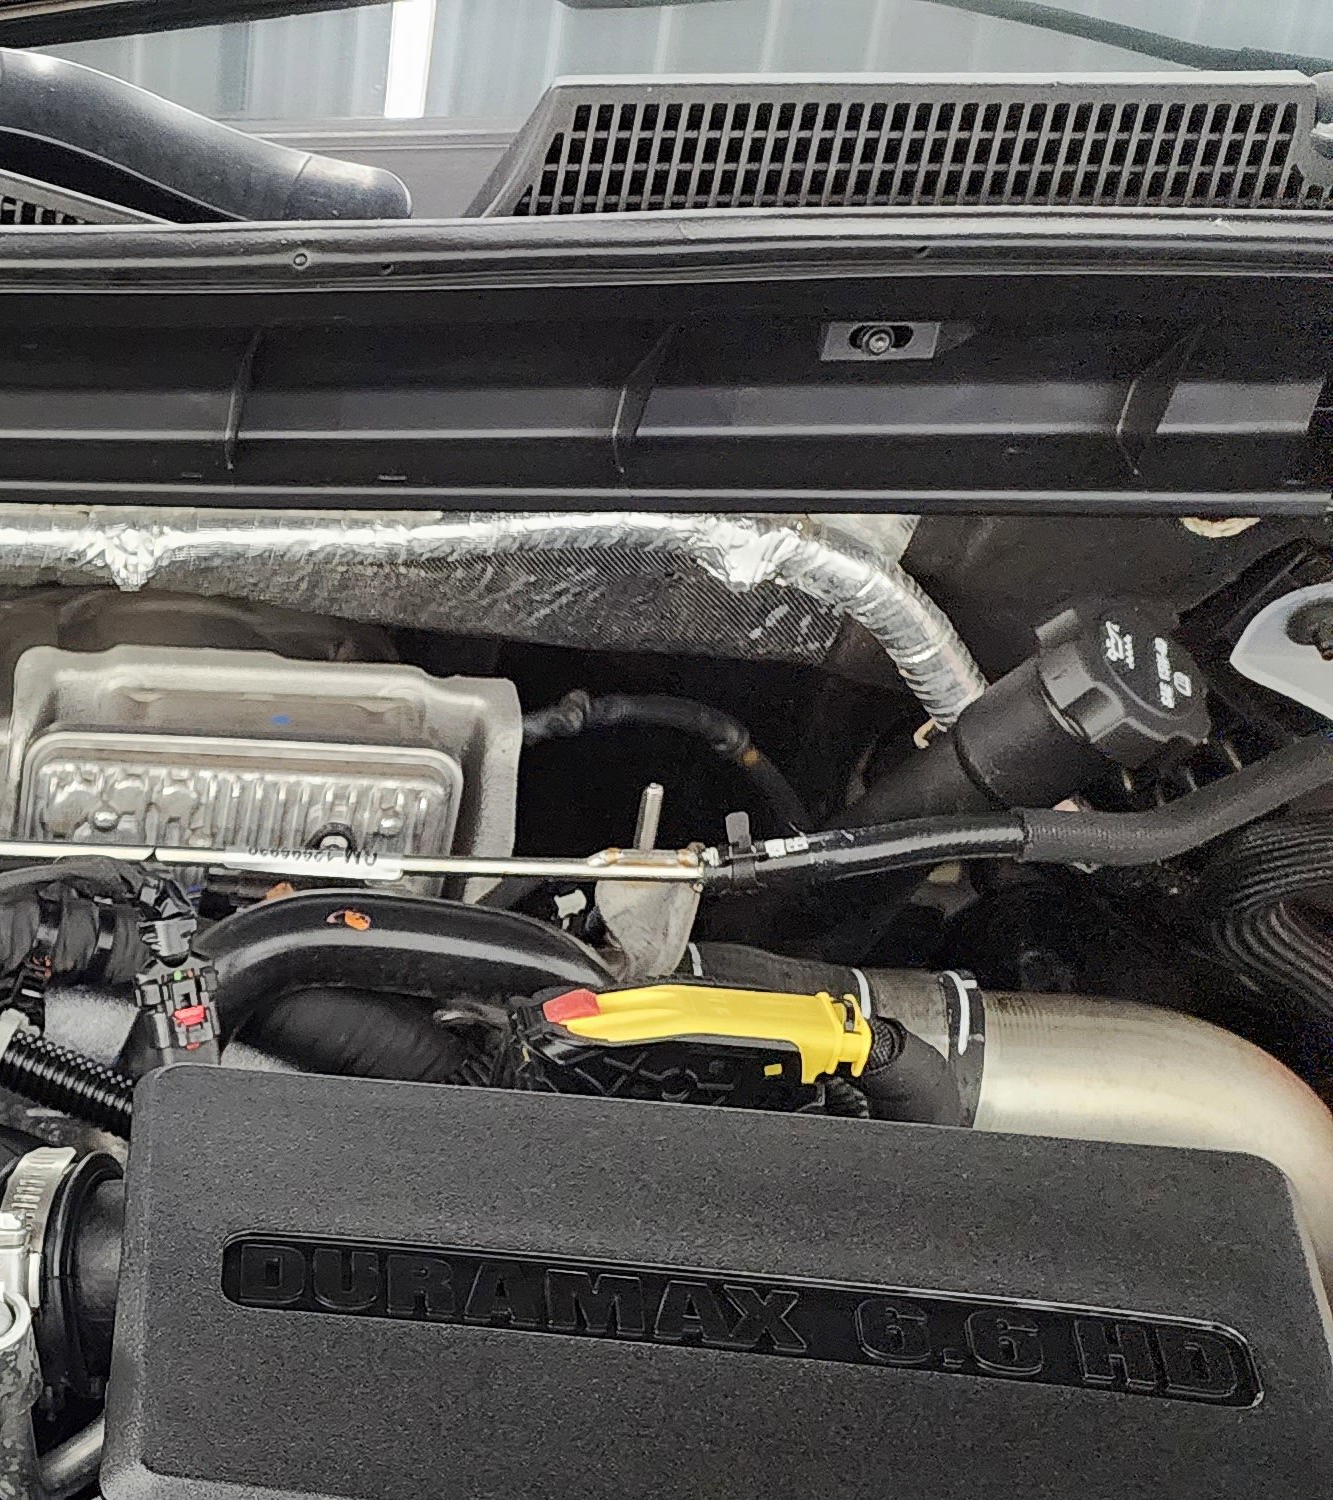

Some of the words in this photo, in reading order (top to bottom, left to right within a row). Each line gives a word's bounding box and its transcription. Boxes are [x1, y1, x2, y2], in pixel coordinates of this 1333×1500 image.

[237, 1240, 808, 1355] DURAMAX
[854, 1294, 1045, 1377] 6.6
[1073, 1318, 1244, 1399] HD
